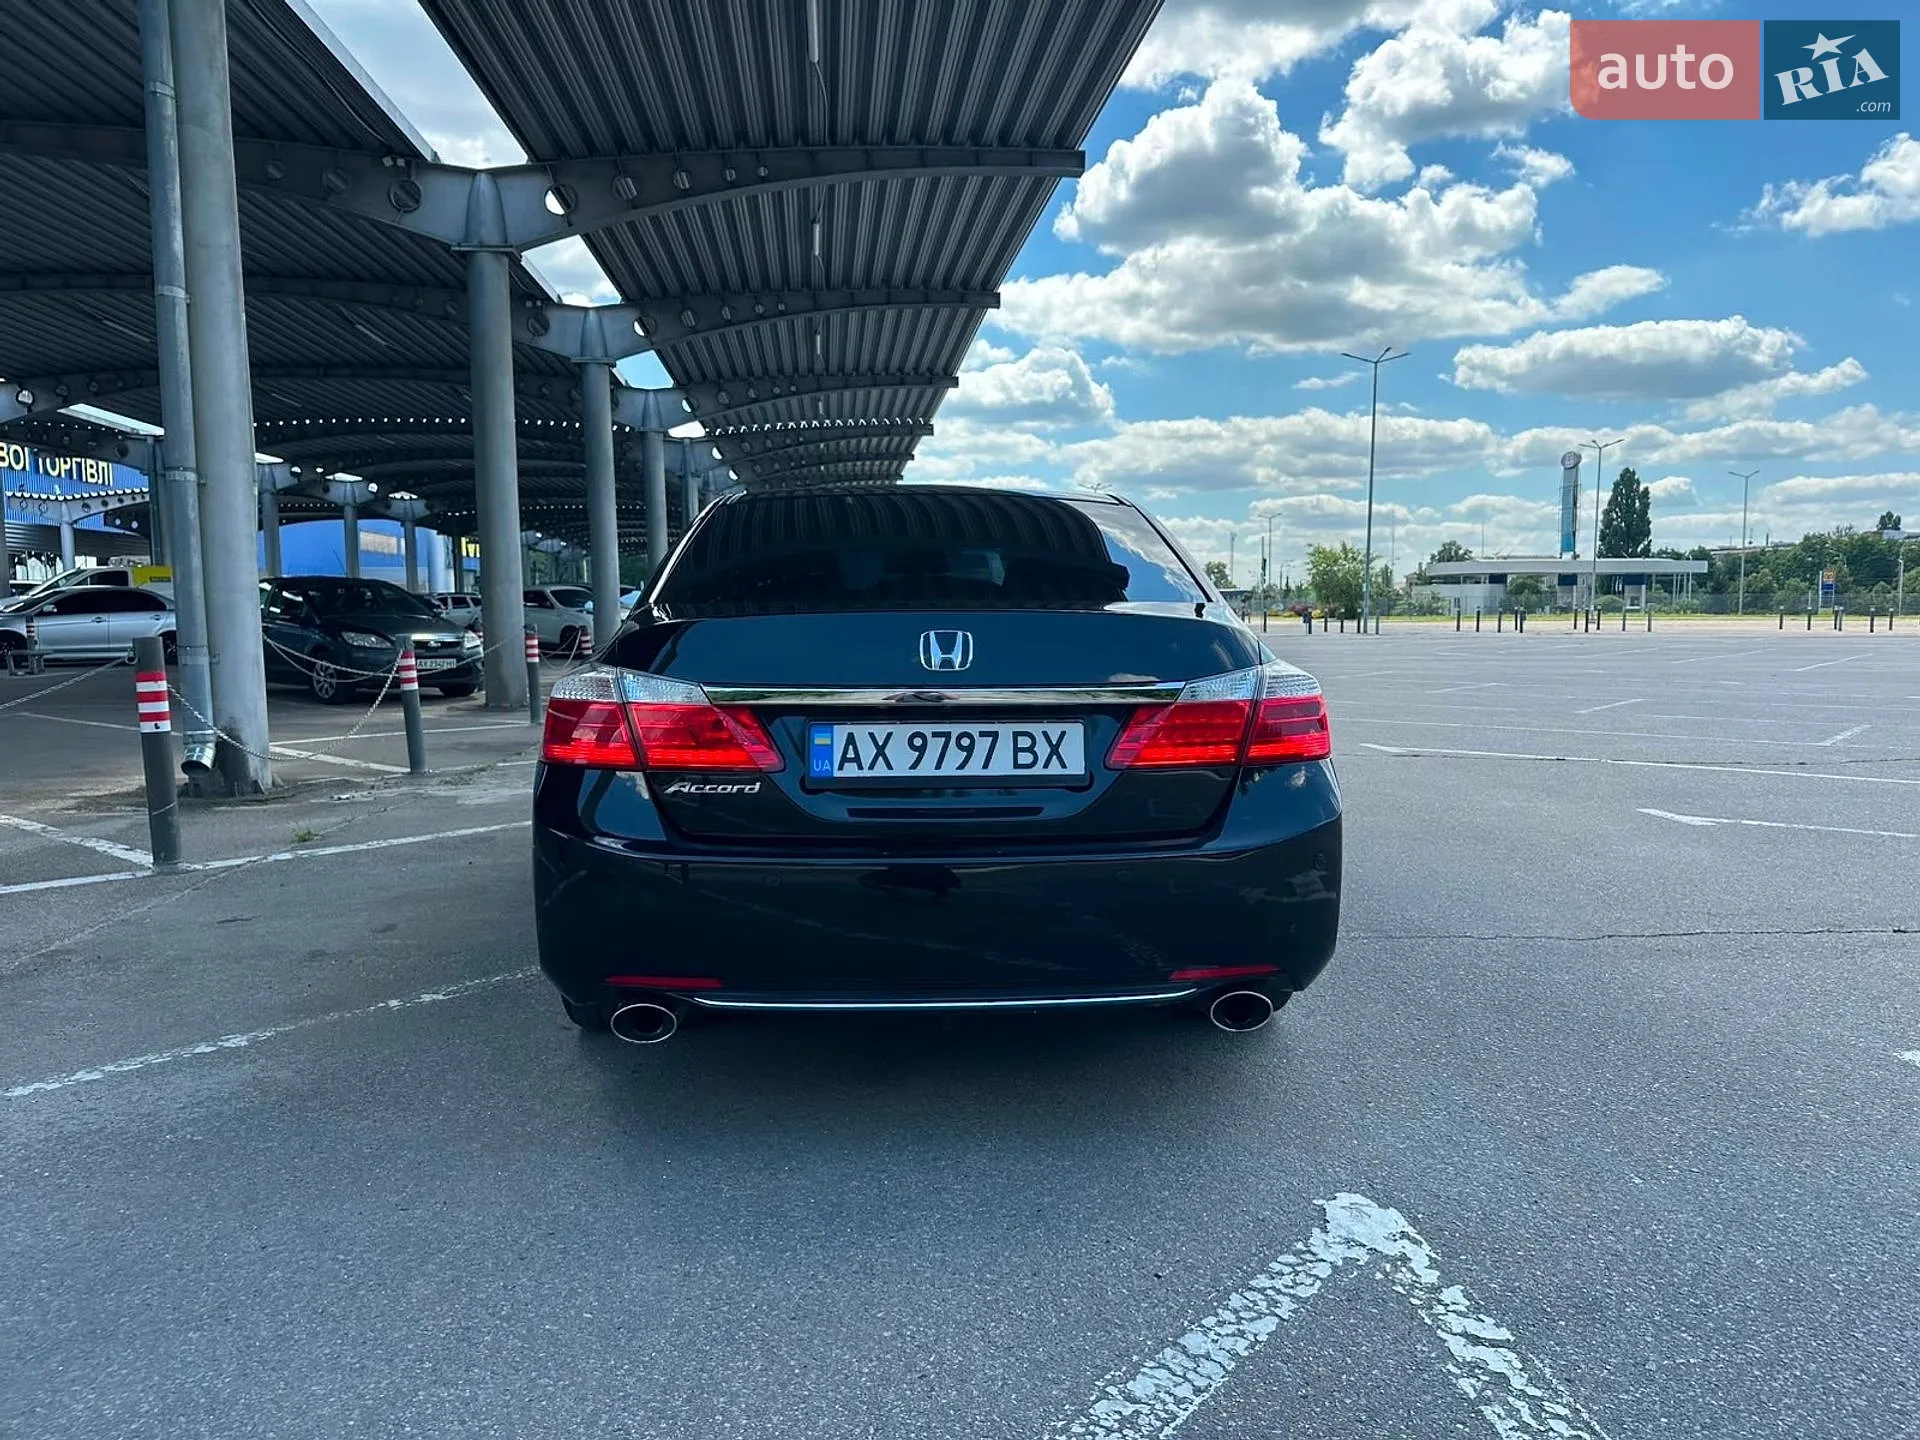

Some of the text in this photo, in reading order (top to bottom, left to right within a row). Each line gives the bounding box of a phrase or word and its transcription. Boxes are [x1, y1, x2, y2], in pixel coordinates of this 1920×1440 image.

[837, 730, 1068, 771] AX 9797 BX
[813, 759, 832, 772] UA
[663, 781, 761, 794] Accord
